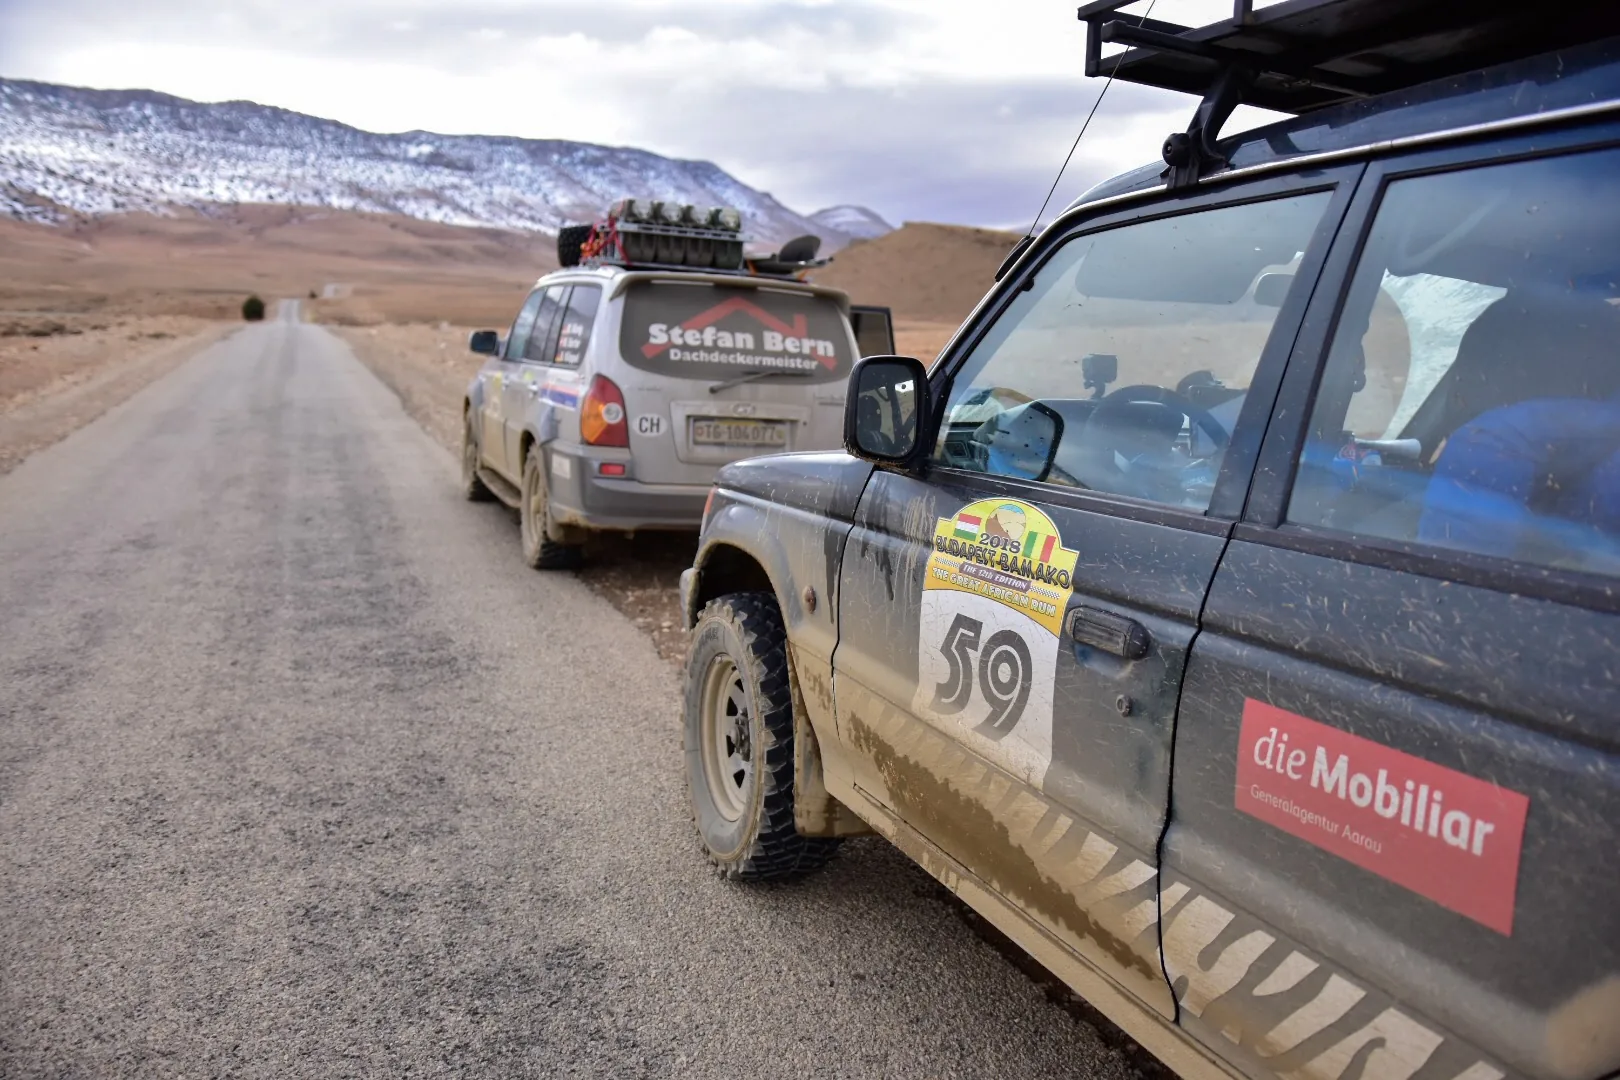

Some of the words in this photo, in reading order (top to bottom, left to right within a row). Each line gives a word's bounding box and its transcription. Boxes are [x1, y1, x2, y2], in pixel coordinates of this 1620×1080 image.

[648, 323, 753, 350] Stefan
[763, 331, 835, 358] Bern
[669, 349, 819, 371] Dachdeckermeister
[638, 416, 661, 435] CH
[936, 535, 1070, 589] BUDAPEST-BAMAKO
[979, 533, 1021, 553] 2018
[932, 567, 949, 582] THE
[950, 573, 981, 592] GREAT
[981, 582, 1029, 609] AFRICAN
[1030, 598, 1056, 617] RUN
[963, 564, 977, 575] THE
[994, 574, 1028, 590] EDITION
[929, 612, 1033, 742] 59
[1253, 727, 1306, 781] die
[1309, 745, 1495, 857] Mobiliar
[1250, 784, 1339, 834] Generalagentur
[1341, 824, 1382, 854] Aarau
